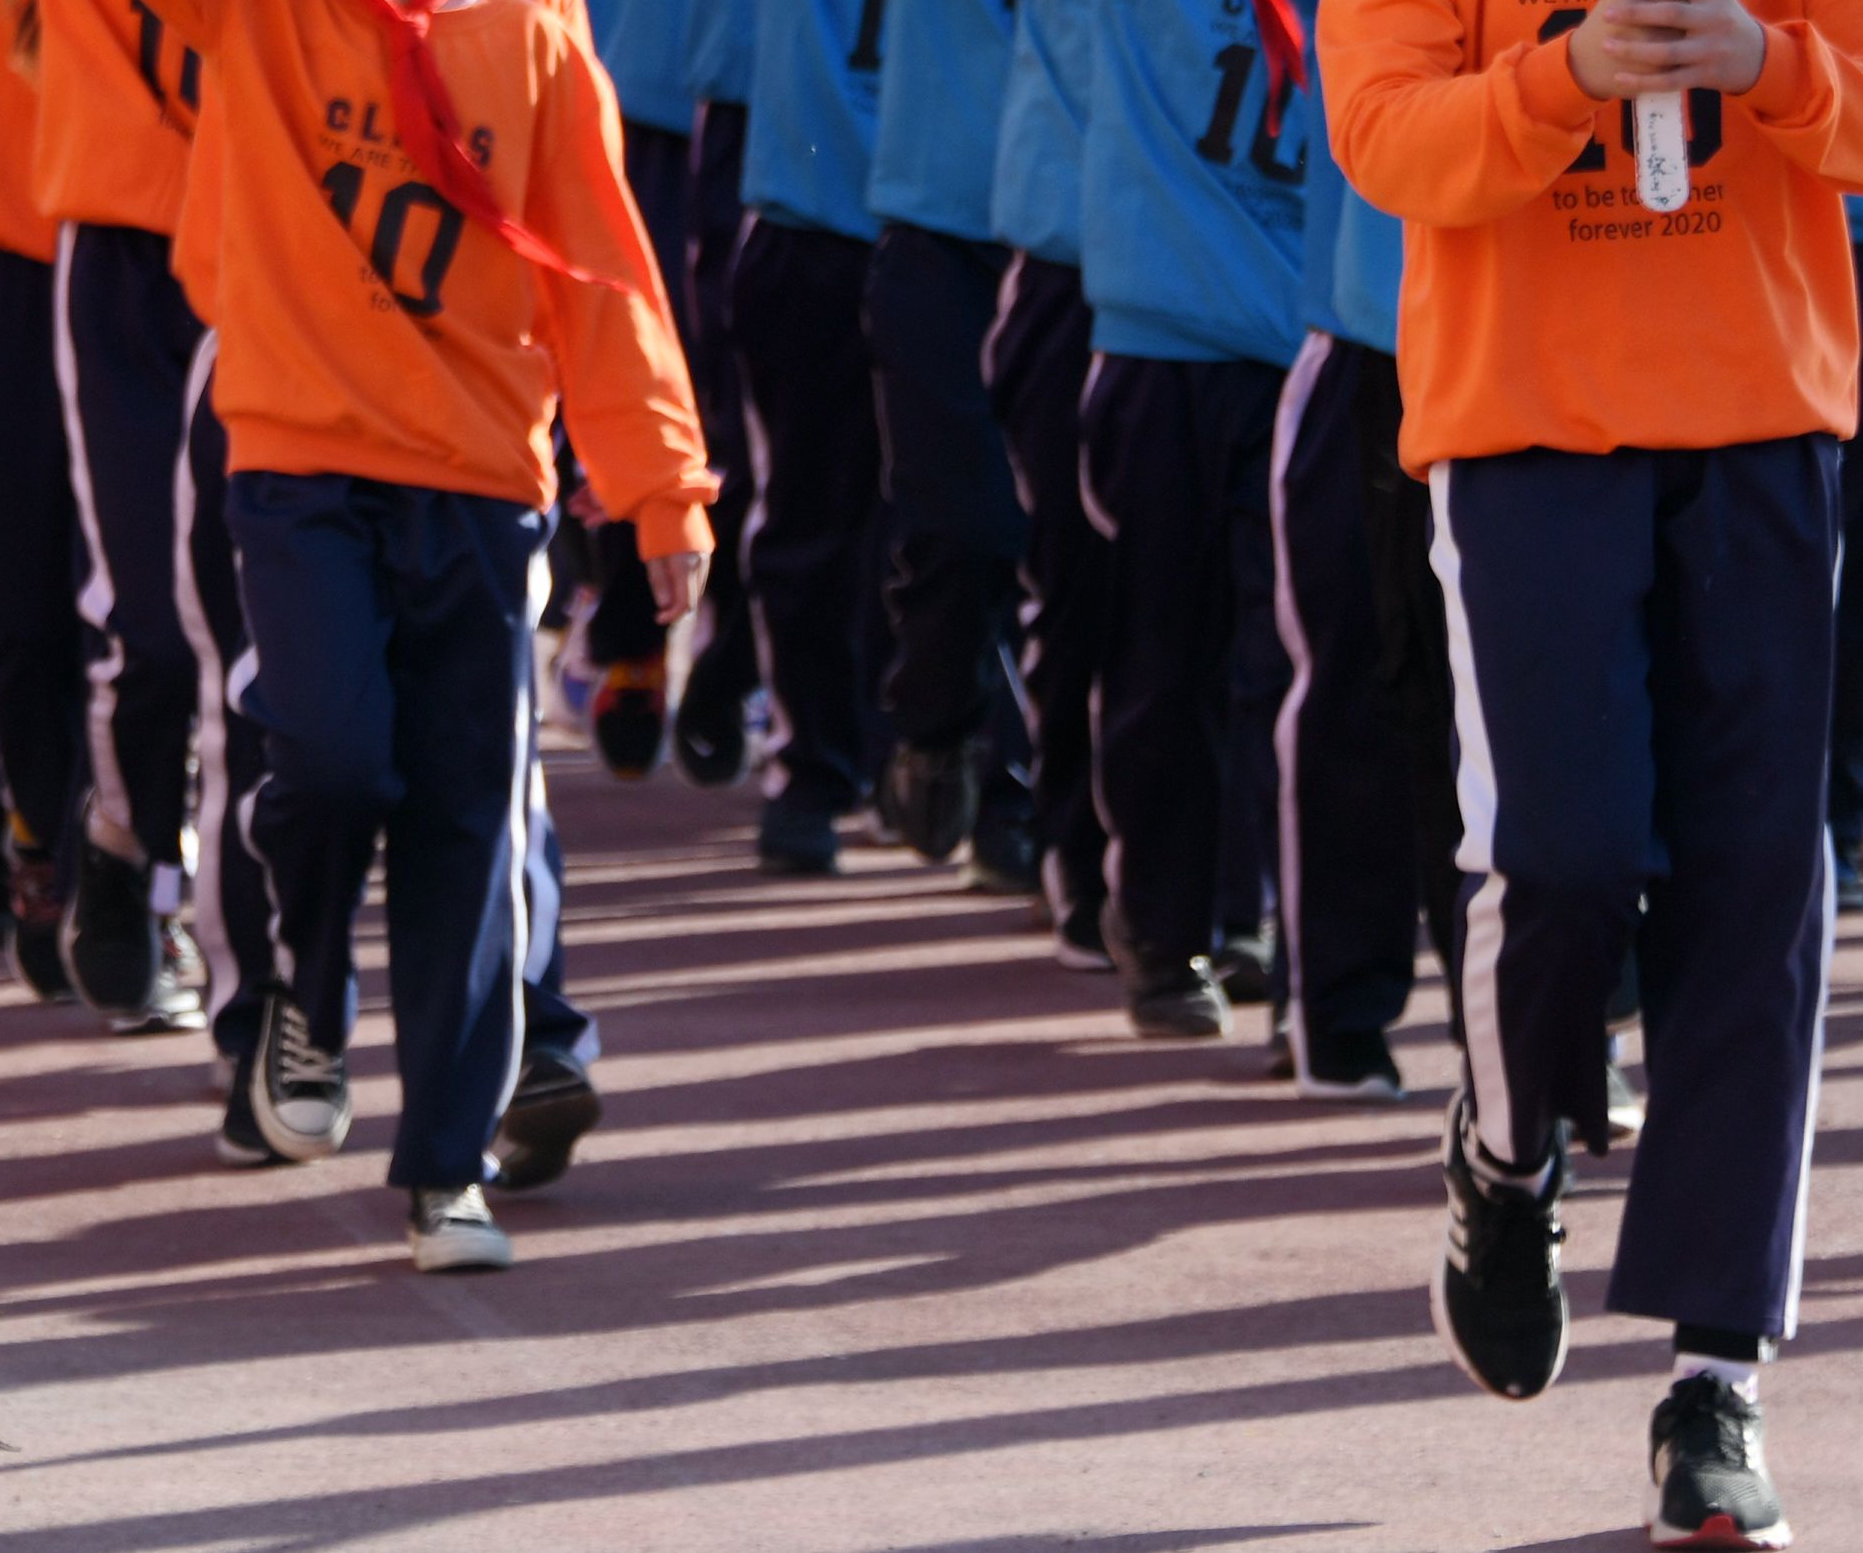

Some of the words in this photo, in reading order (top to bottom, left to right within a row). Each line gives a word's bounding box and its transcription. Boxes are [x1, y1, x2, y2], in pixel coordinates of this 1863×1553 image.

[327, 98, 495, 169] CLS
[1553, 189, 1578, 209] to
[1584, 185, 1614, 207] be
[1569, 219, 1652, 241] forever
[1660, 211, 1722, 236] 2020
